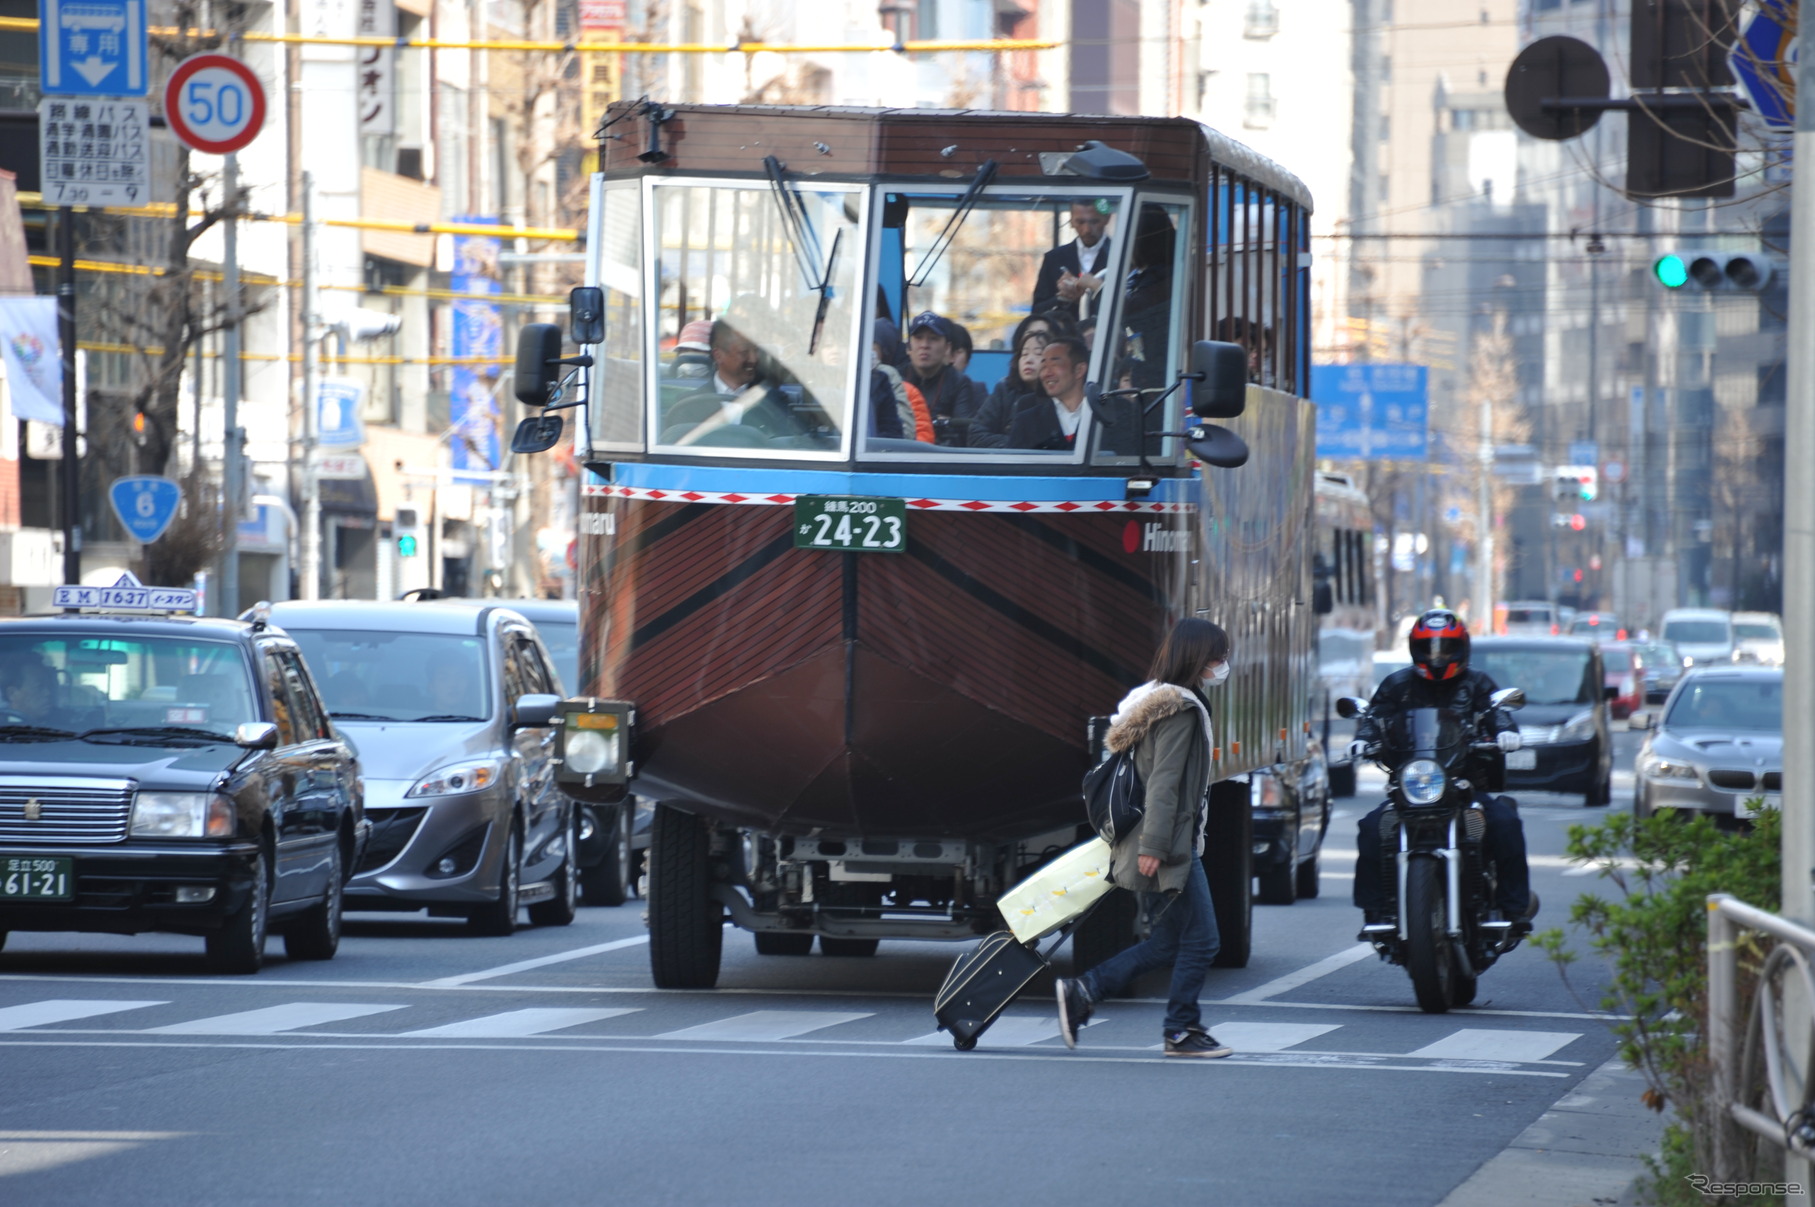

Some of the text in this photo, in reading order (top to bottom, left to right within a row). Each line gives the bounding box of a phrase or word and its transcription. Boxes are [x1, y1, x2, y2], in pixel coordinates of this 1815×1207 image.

[69, 33, 120, 55] 専用
[189, 82, 242, 127] 50
[136, 491, 155, 517] 6
[813, 513, 902, 548] 24-23
[104, 592, 145, 605] 1637
[5, 873, 65, 895] 61-21
